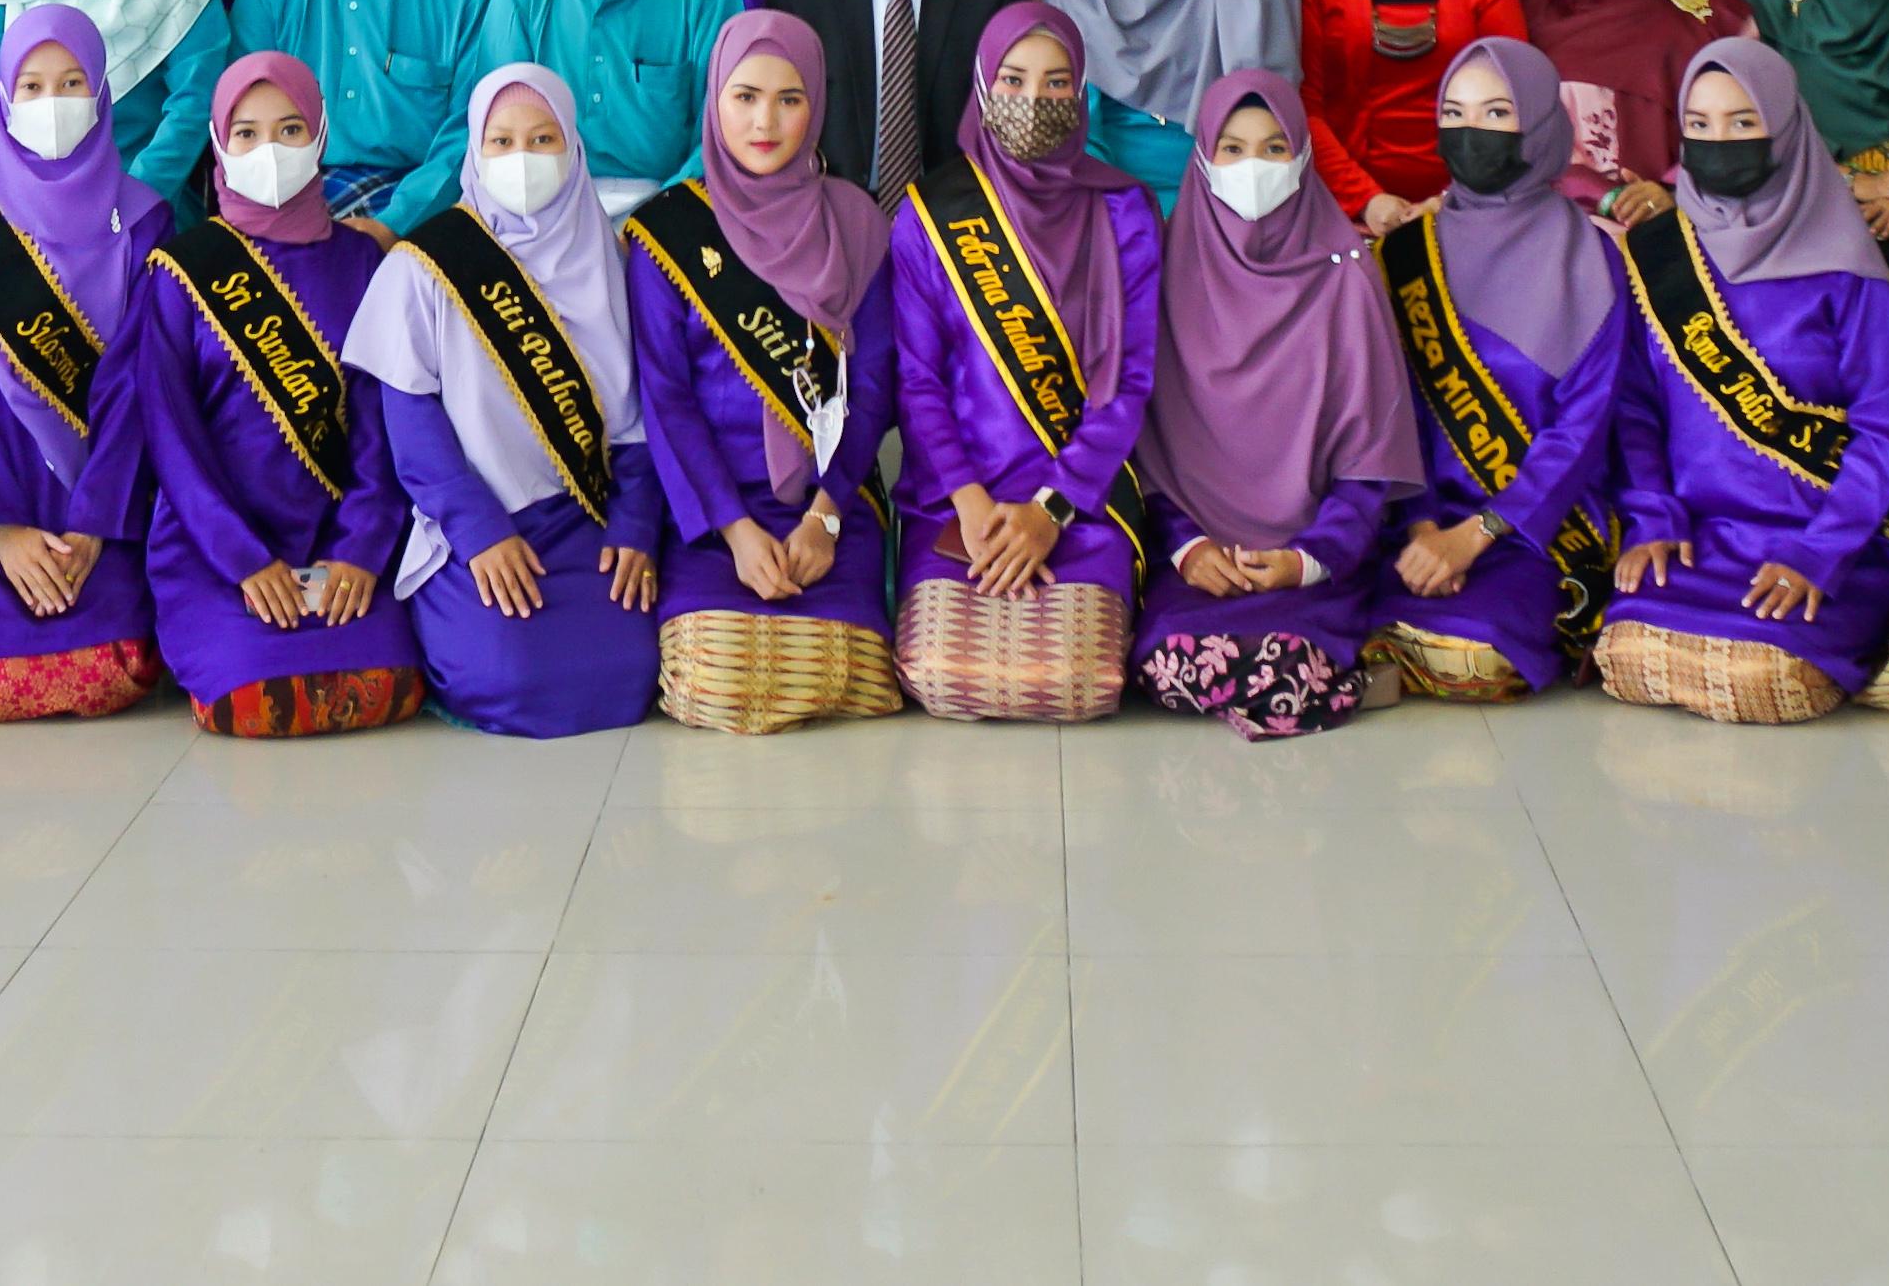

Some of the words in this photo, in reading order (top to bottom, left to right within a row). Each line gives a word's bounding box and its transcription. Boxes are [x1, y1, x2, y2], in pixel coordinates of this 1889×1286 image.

[211, 271, 262, 313] Sri
[481, 279, 536, 334] Siti
[737, 305, 799, 361] Siti
